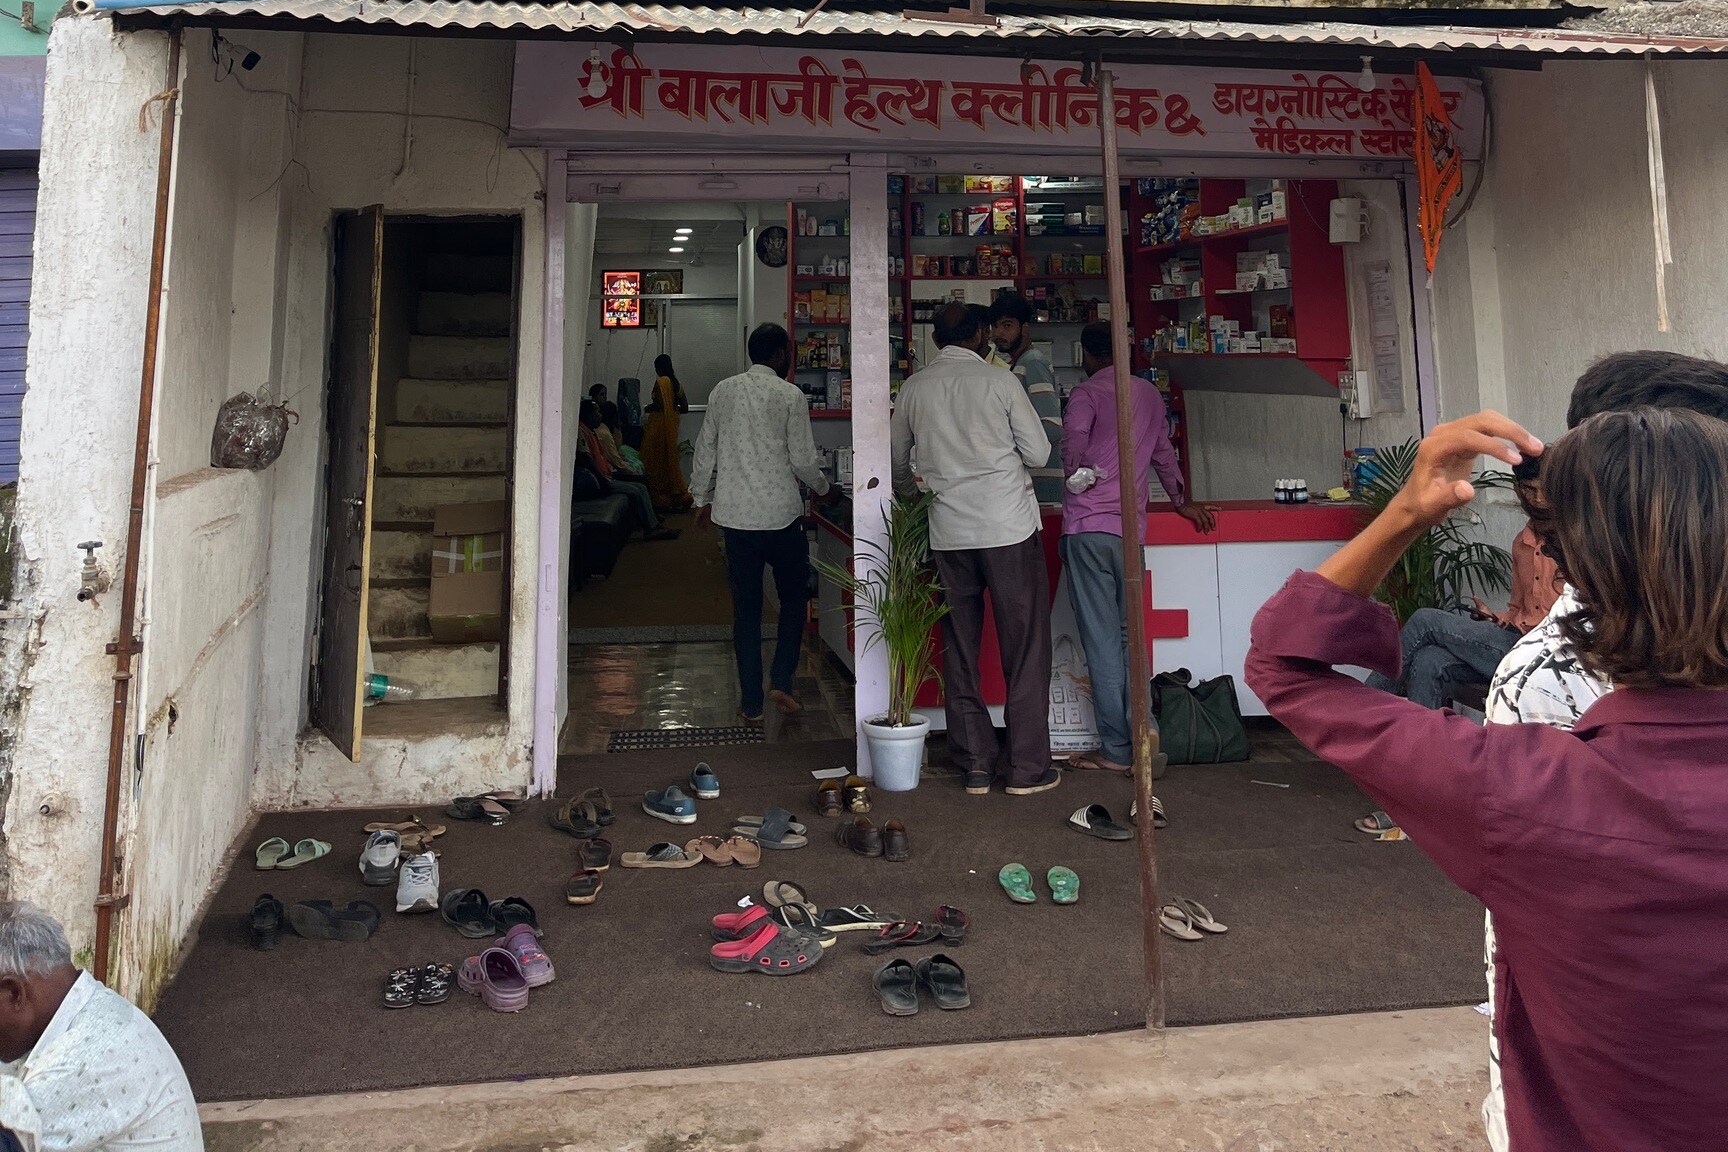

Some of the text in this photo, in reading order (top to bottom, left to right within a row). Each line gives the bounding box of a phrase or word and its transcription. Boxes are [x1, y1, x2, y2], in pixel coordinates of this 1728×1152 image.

[577, 48, 654, 120] श्री
[657, 55, 841, 127] बालाजी
[841, 58, 947, 134] हेल्थ
[1164, 94, 1208, 138] &
[1212, 73, 1387, 123] डायग्नोस्टिक
[1249, 116, 1354, 155] मेडिकल
